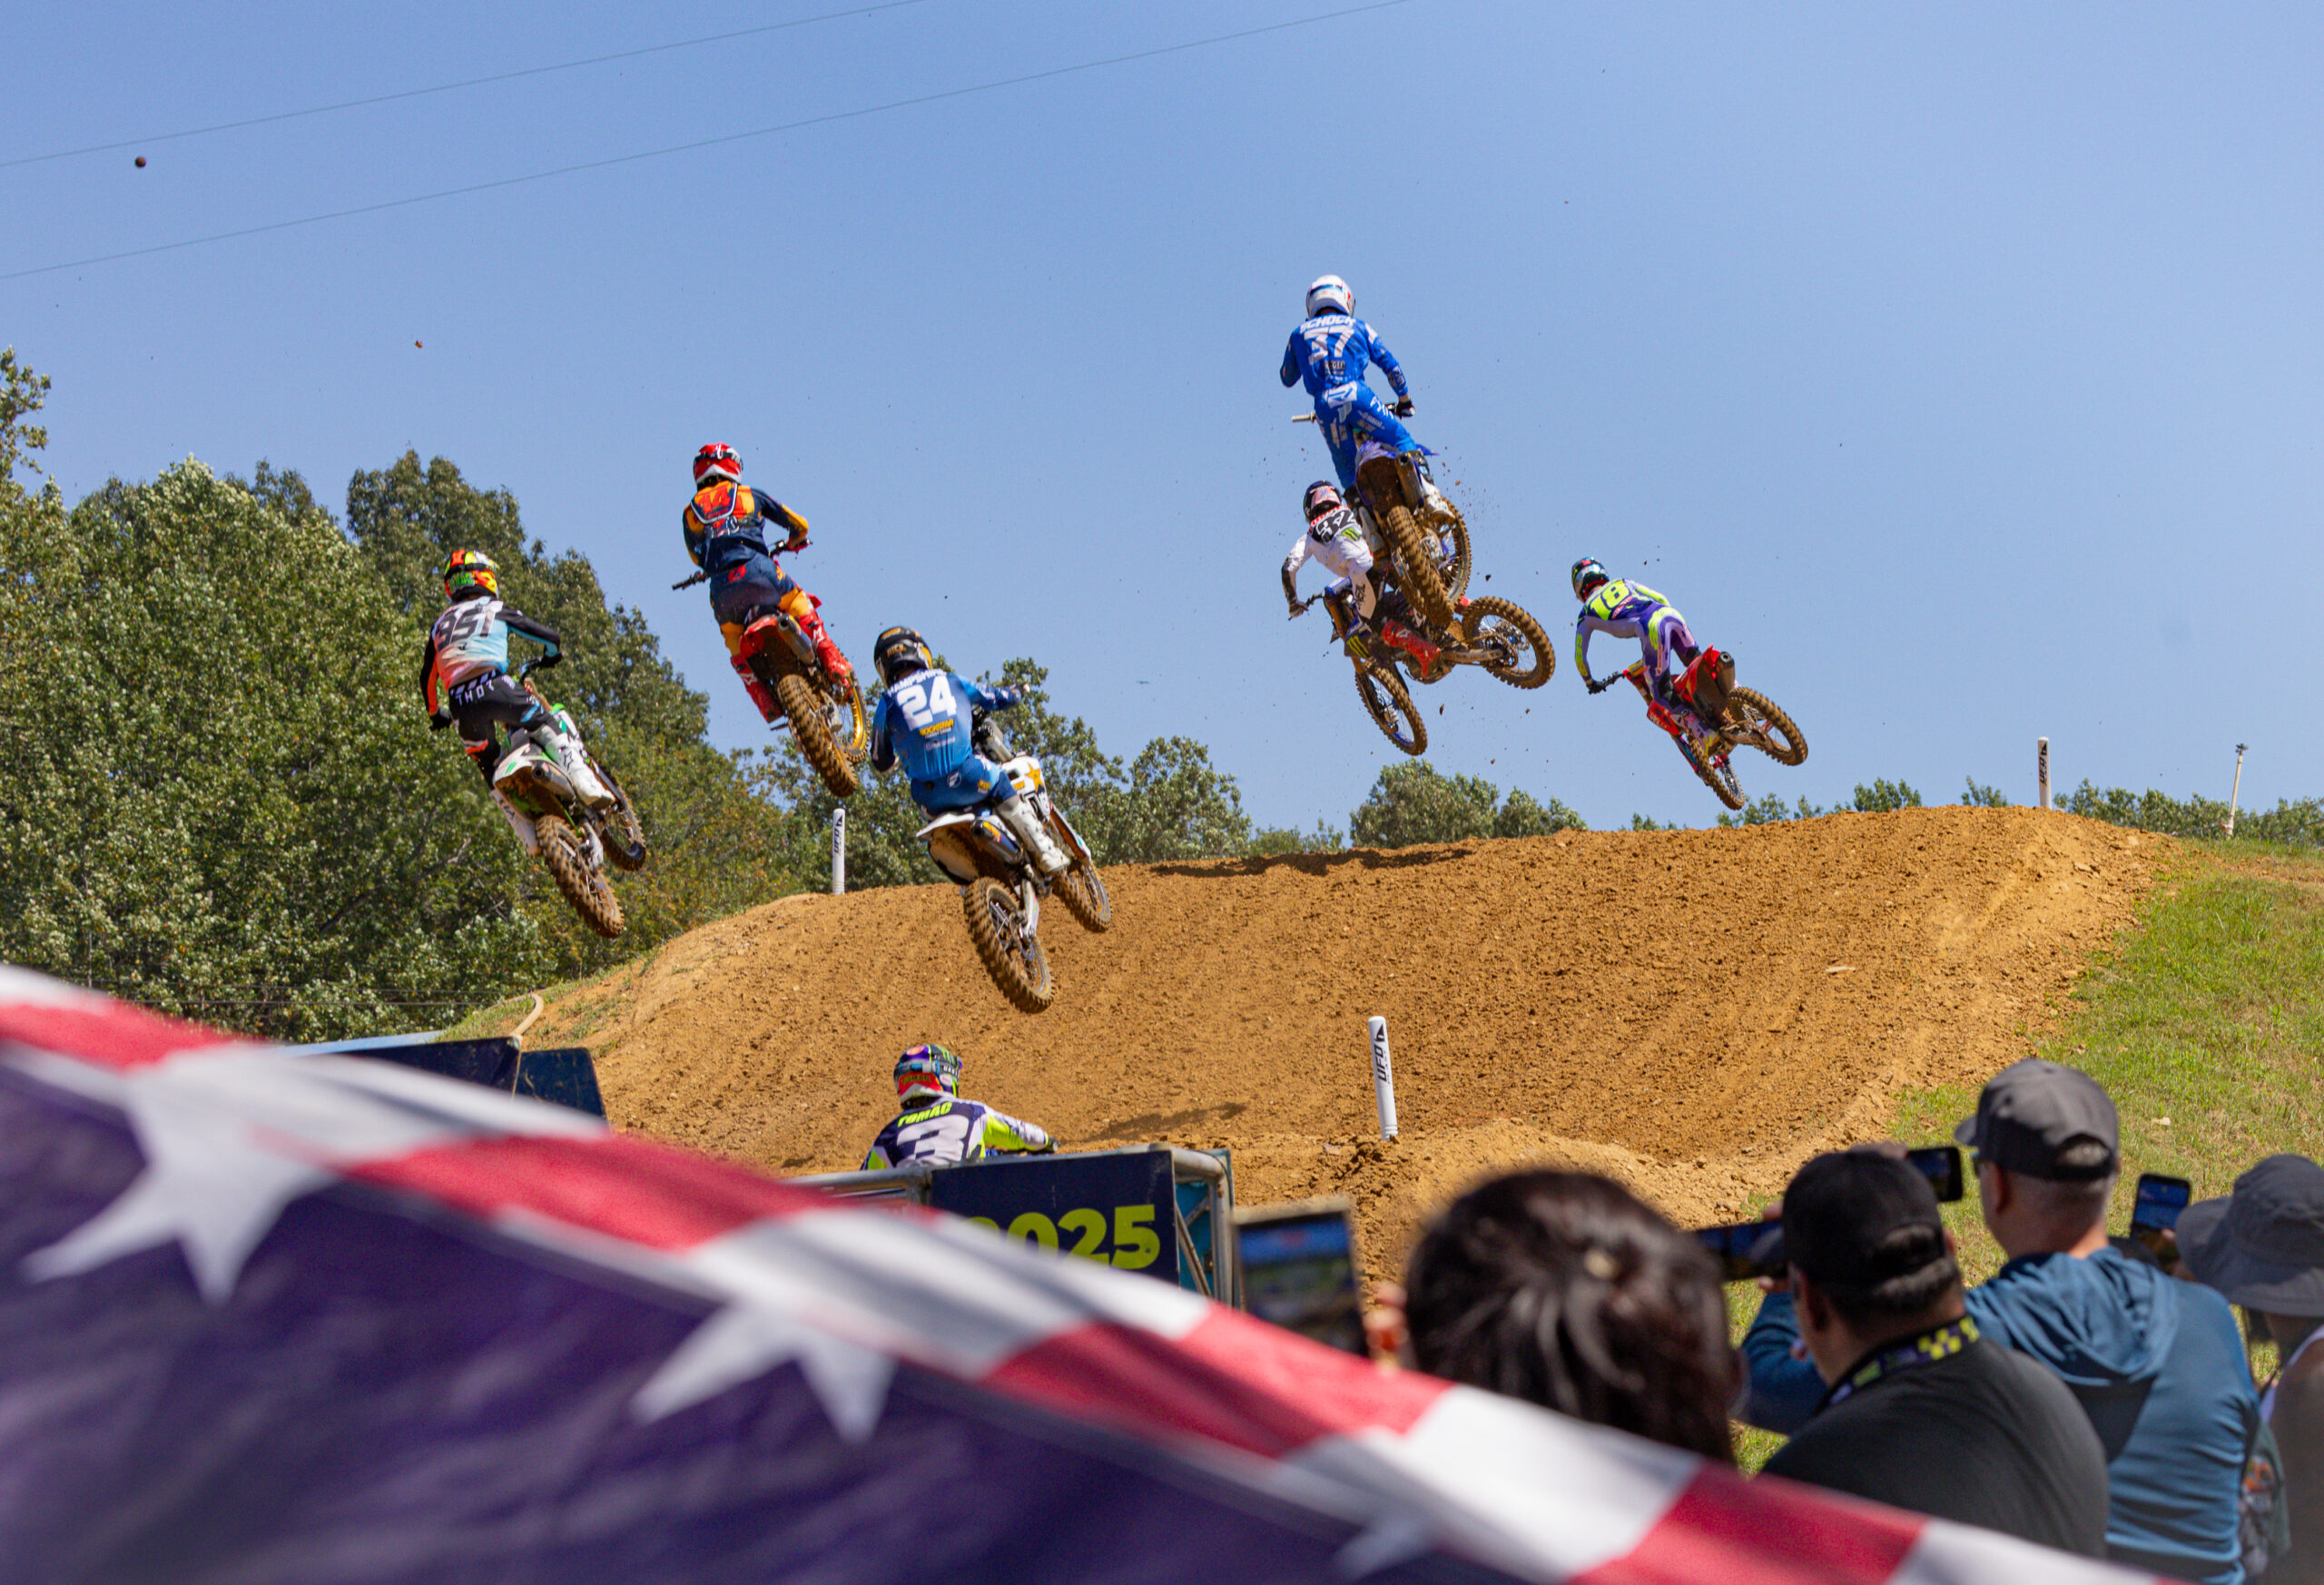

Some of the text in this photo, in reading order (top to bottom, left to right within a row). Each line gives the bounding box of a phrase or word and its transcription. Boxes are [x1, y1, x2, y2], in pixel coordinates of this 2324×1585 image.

[1305, 326, 1354, 365] 37
[696, 485, 731, 515] 14
[1316, 509, 1356, 544] 32
[1588, 580, 1630, 621] 18
[896, 675, 957, 732] 24
[1374, 1044, 1387, 1082] UFO
[897, 1102, 952, 1127] TOMAC
[896, 1114, 970, 1166] 3
